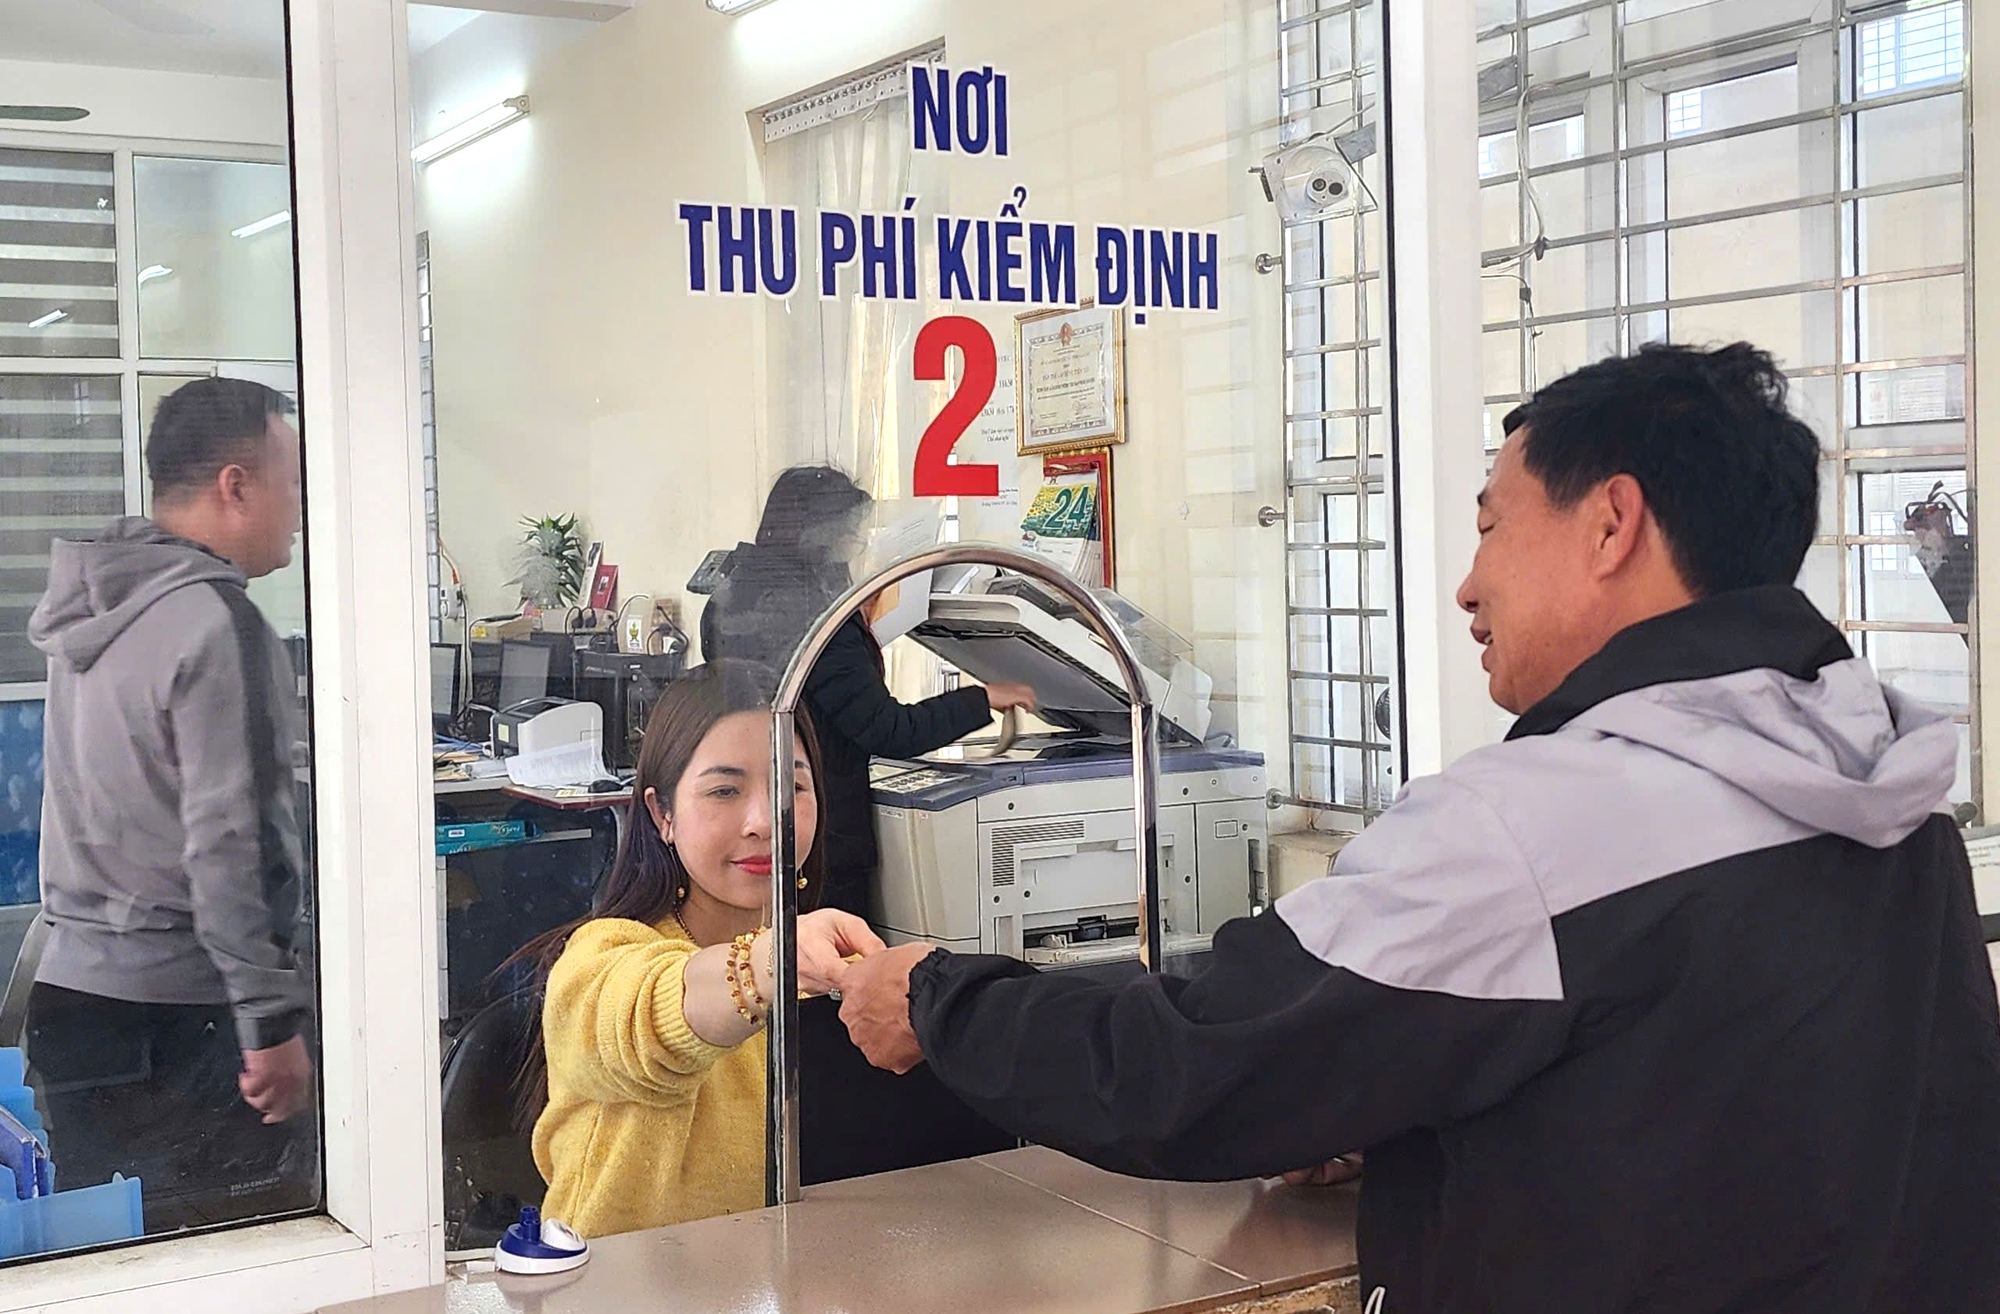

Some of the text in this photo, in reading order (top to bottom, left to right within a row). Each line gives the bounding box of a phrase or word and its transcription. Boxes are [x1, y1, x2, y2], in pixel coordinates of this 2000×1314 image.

[913, 67, 1008, 155] NƠI
[680, 187, 1217, 325] THU PHÍ KIỂM ĐỊNH
[914, 316, 999, 497] 2
[1045, 486, 1089, 528] 24
